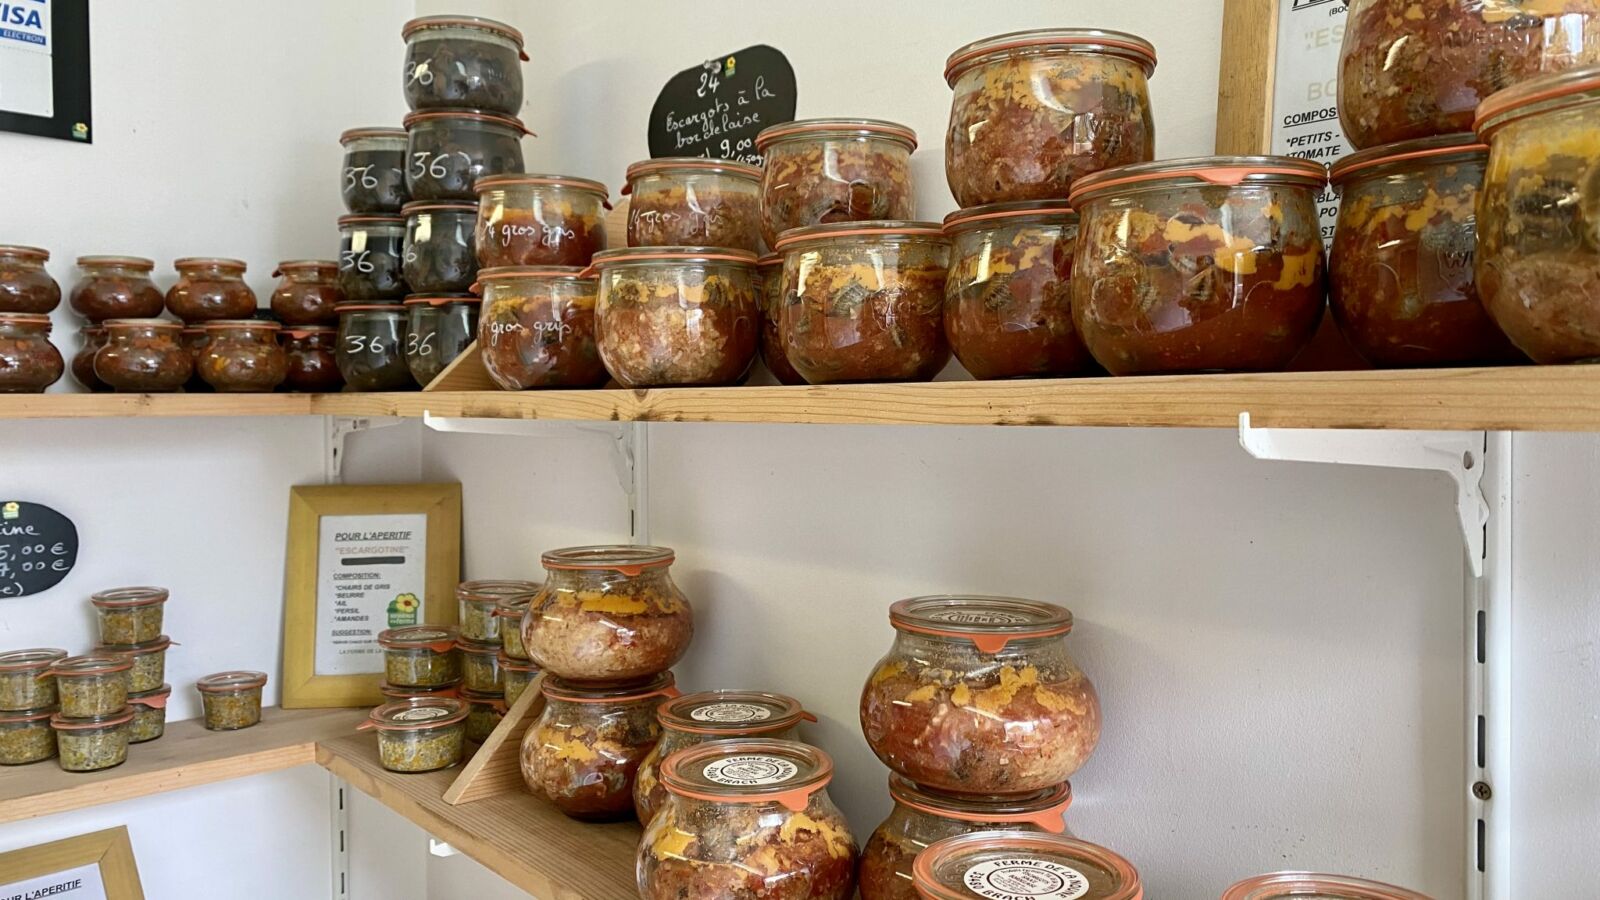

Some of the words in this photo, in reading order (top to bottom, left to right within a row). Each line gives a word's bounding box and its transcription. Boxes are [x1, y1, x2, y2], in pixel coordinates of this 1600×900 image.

[0, 3, 42, 29] ISA
[2, 30, 44, 43] ELECTRON
[697, 72, 720, 97] 24
[666, 98, 730, 132] Escargots
[755, 75, 776, 100] la
[1283, 107, 1337, 126] COMPOS
[675, 111, 761, 149] bordelaise
[720, 138, 752, 159] 9,00
[412, 151, 449, 181] 36
[344, 163, 378, 192] 36
[502, 224, 536, 247] gros
[341, 250, 374, 273] 36
[345, 335, 386, 354] 36
[406, 332, 436, 356] 36
[490, 321, 525, 347] gros
[334, 532, 362, 542] POUR
[363, 530, 413, 541] L'APERITIF
[335, 545, 410, 556] "ESCARGOTINE"
[726, 756, 762, 764] FERME
[719, 777, 758, 785] BRACH
[993, 859, 1043, 868] FERME
[1044, 863, 1065, 872] DE
[1062, 871, 1078, 880] LA
[25, 878, 83, 900] L'APERITIF
[982, 889, 1037, 900] BRACH
